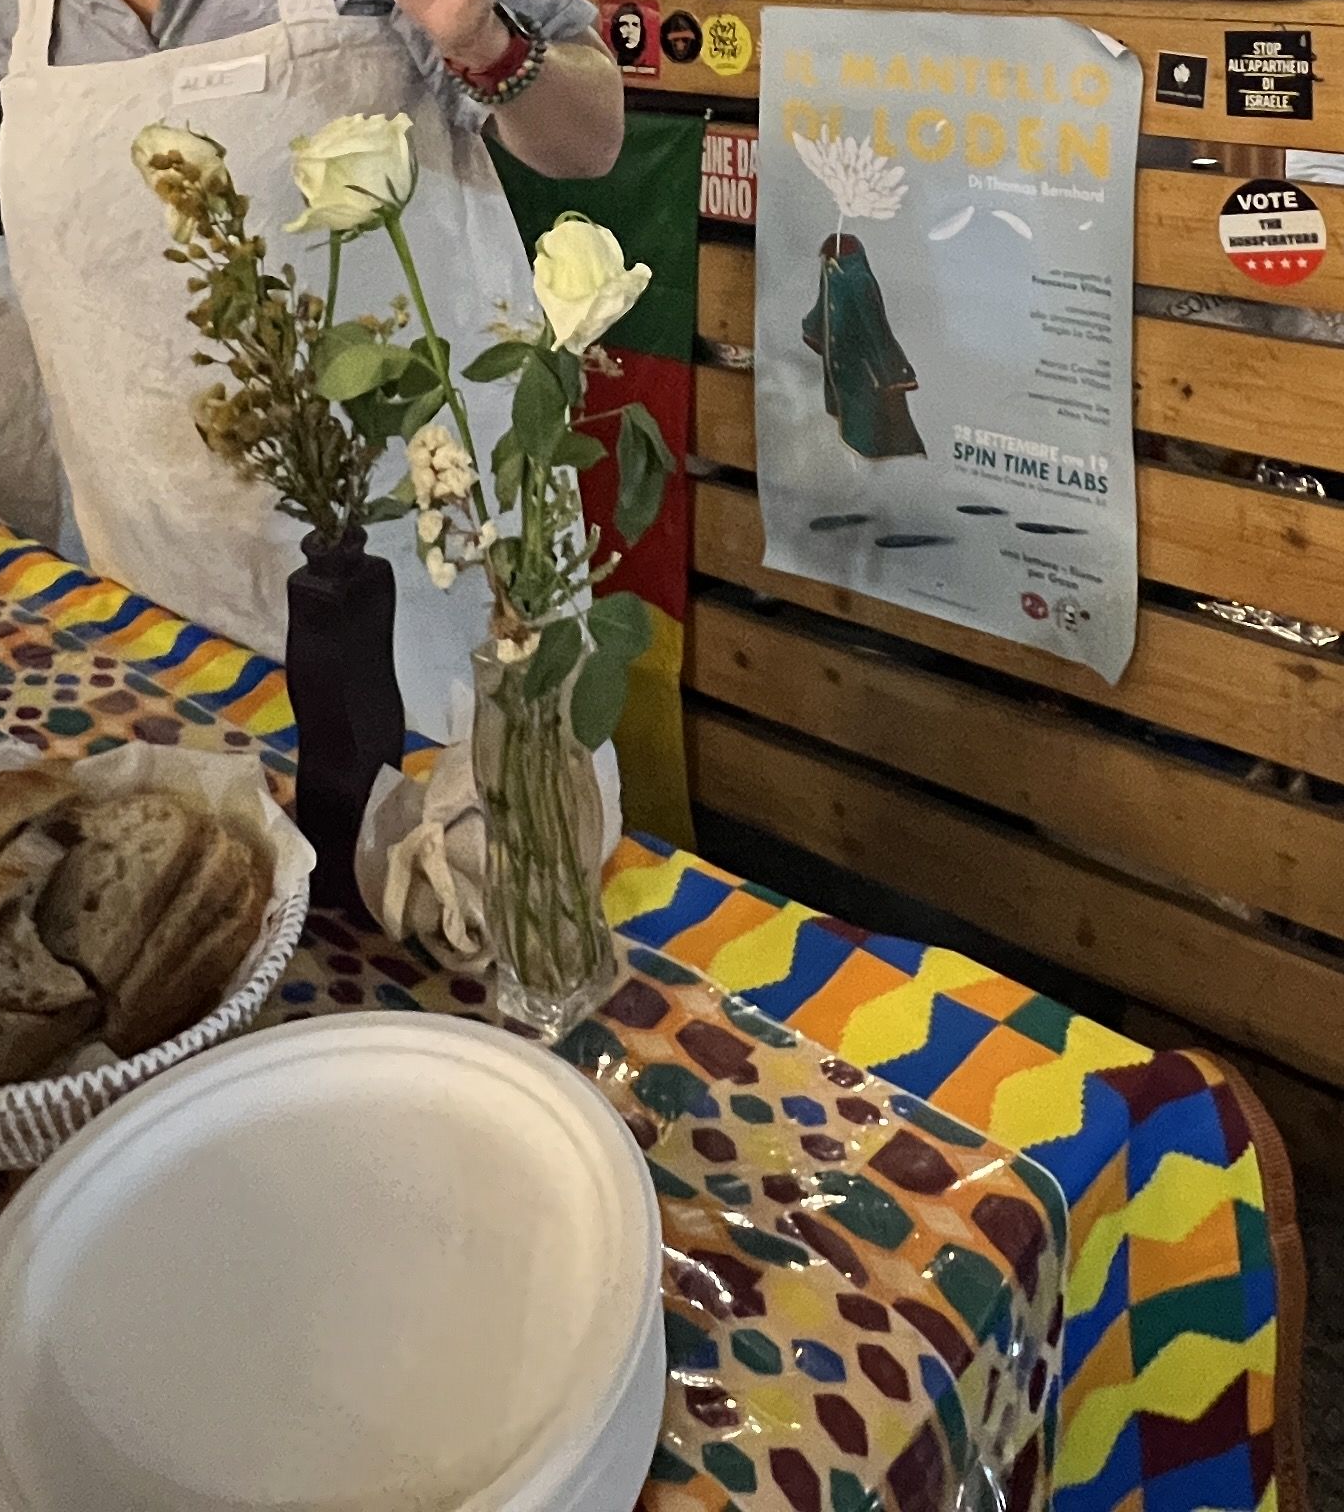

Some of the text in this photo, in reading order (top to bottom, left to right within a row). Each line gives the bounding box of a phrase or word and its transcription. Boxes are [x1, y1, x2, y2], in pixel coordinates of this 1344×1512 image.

[1253, 41, 1282, 55] STOP
[1228, 58, 1309, 74] ALL'APARTHEID
[783, 48, 1112, 109] IL MANTELLO
[1262, 77, 1275, 90] DI
[1245, 94, 1290, 108] ISRAELE
[781, 97, 1113, 181] DI LODEN
[985, 175, 1038, 196] Thomas
[1040, 181, 1105, 203] Bernhard
[1237, 190, 1299, 210] VOTE
[973, 428, 1060, 462] SETTEMBRE
[1089, 454, 1109, 474] 19
[953, 441, 1109, 494] SPIN TIME LABS
